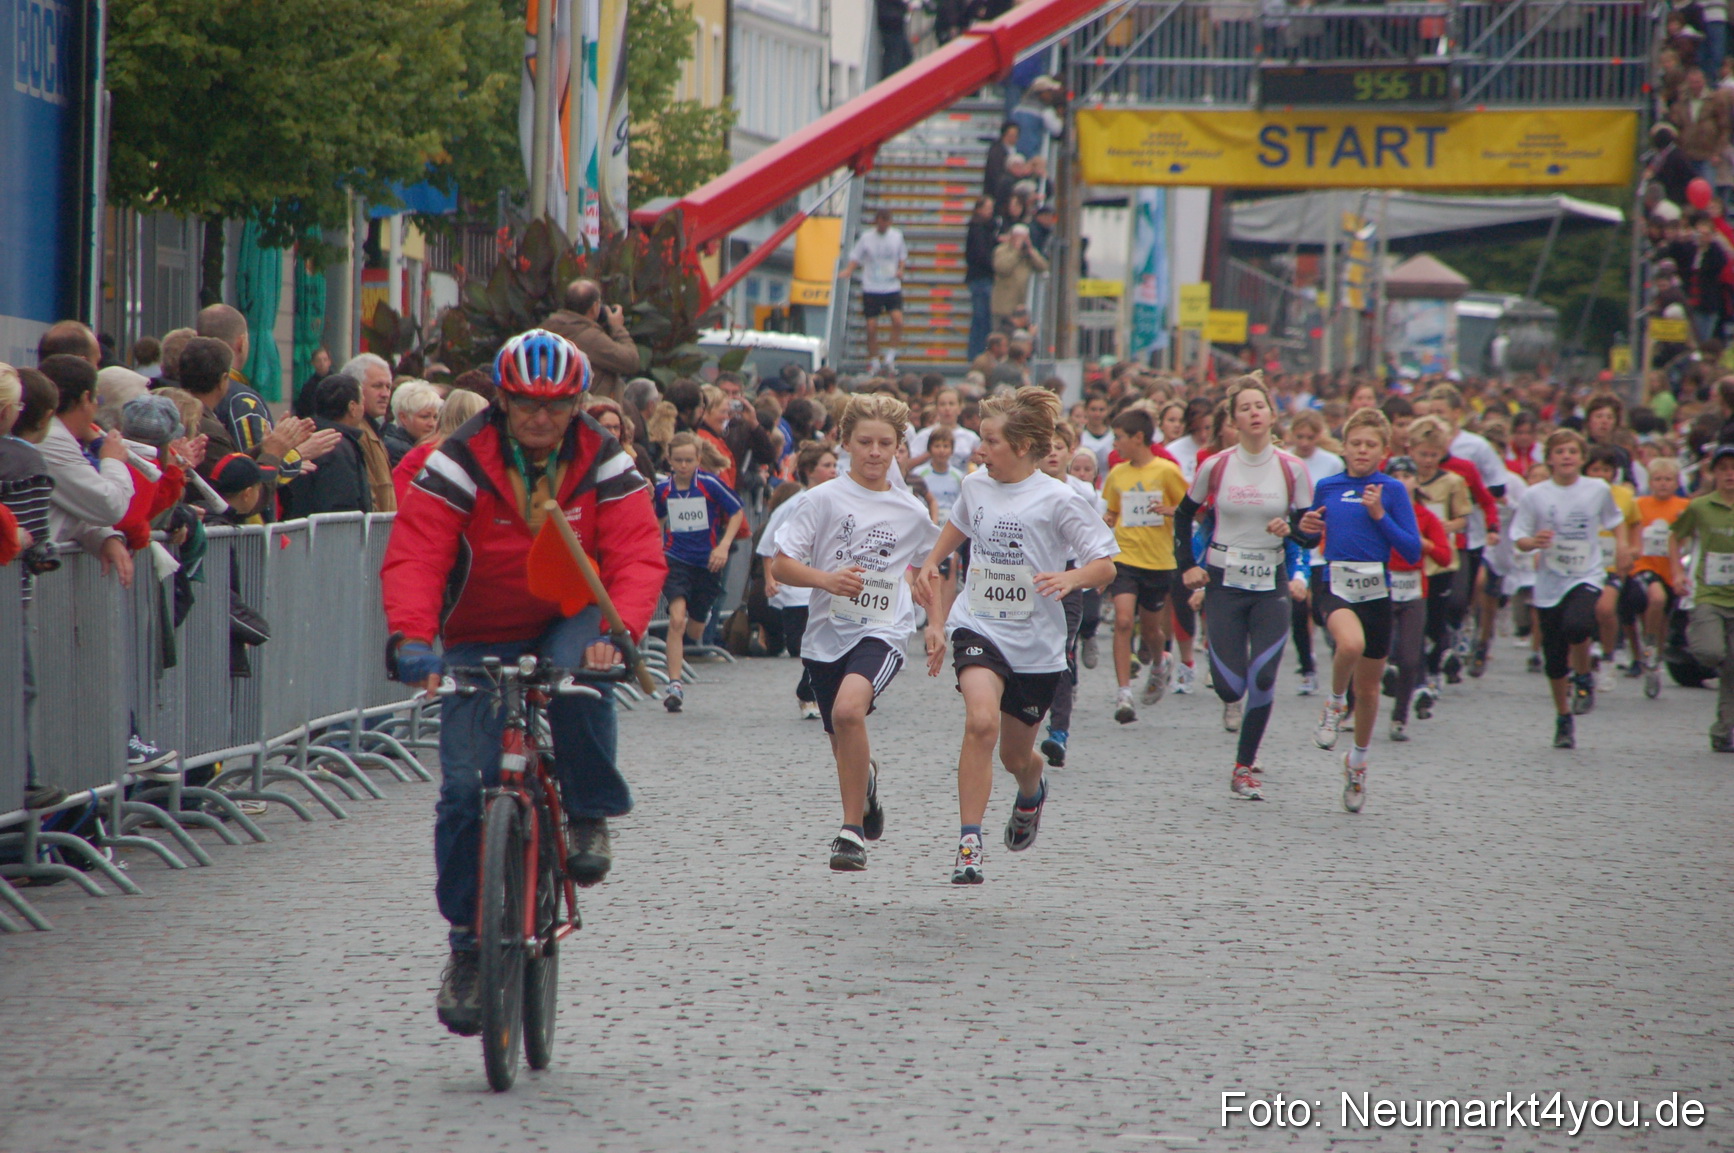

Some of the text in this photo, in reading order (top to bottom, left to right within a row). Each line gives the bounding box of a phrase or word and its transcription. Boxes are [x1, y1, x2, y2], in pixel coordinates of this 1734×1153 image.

[1257, 124, 1447, 169] START
[678, 510, 704, 521] 4090
[991, 530, 1024, 540] 21.09.2008
[981, 548, 1024, 559] Neumarkter
[990, 556, 1025, 566] Stadtlauf
[984, 568, 1015, 581] Thomas
[1239, 564, 1271, 578] 4104
[1346, 576, 1380, 589] 4100
[984, 586, 1026, 601] 4040
[849, 592, 889, 611] 4019
